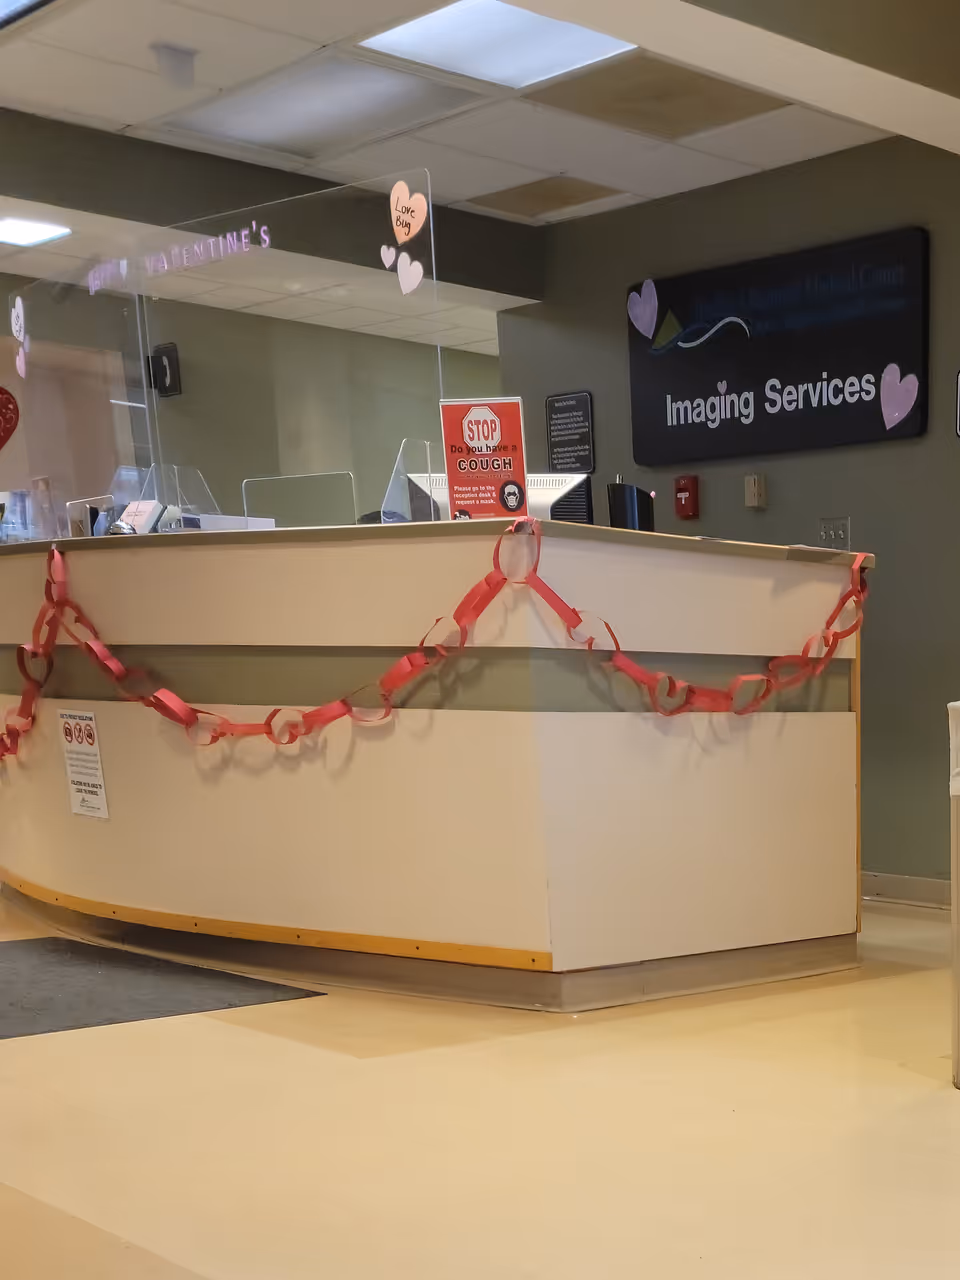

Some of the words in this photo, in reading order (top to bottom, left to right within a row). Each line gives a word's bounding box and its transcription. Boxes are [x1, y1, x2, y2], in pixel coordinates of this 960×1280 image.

[395, 196, 415, 219] Love
[396, 215, 411, 236] Bug
[666, 389, 754, 429] Imaging
[764, 372, 876, 414] Services
[467, 418, 497, 442] STOP
[450, 444, 463, 453] Do
[466, 445, 483, 455] you
[486, 444, 509, 453] have
[457, 457, 513, 472] COUGH
